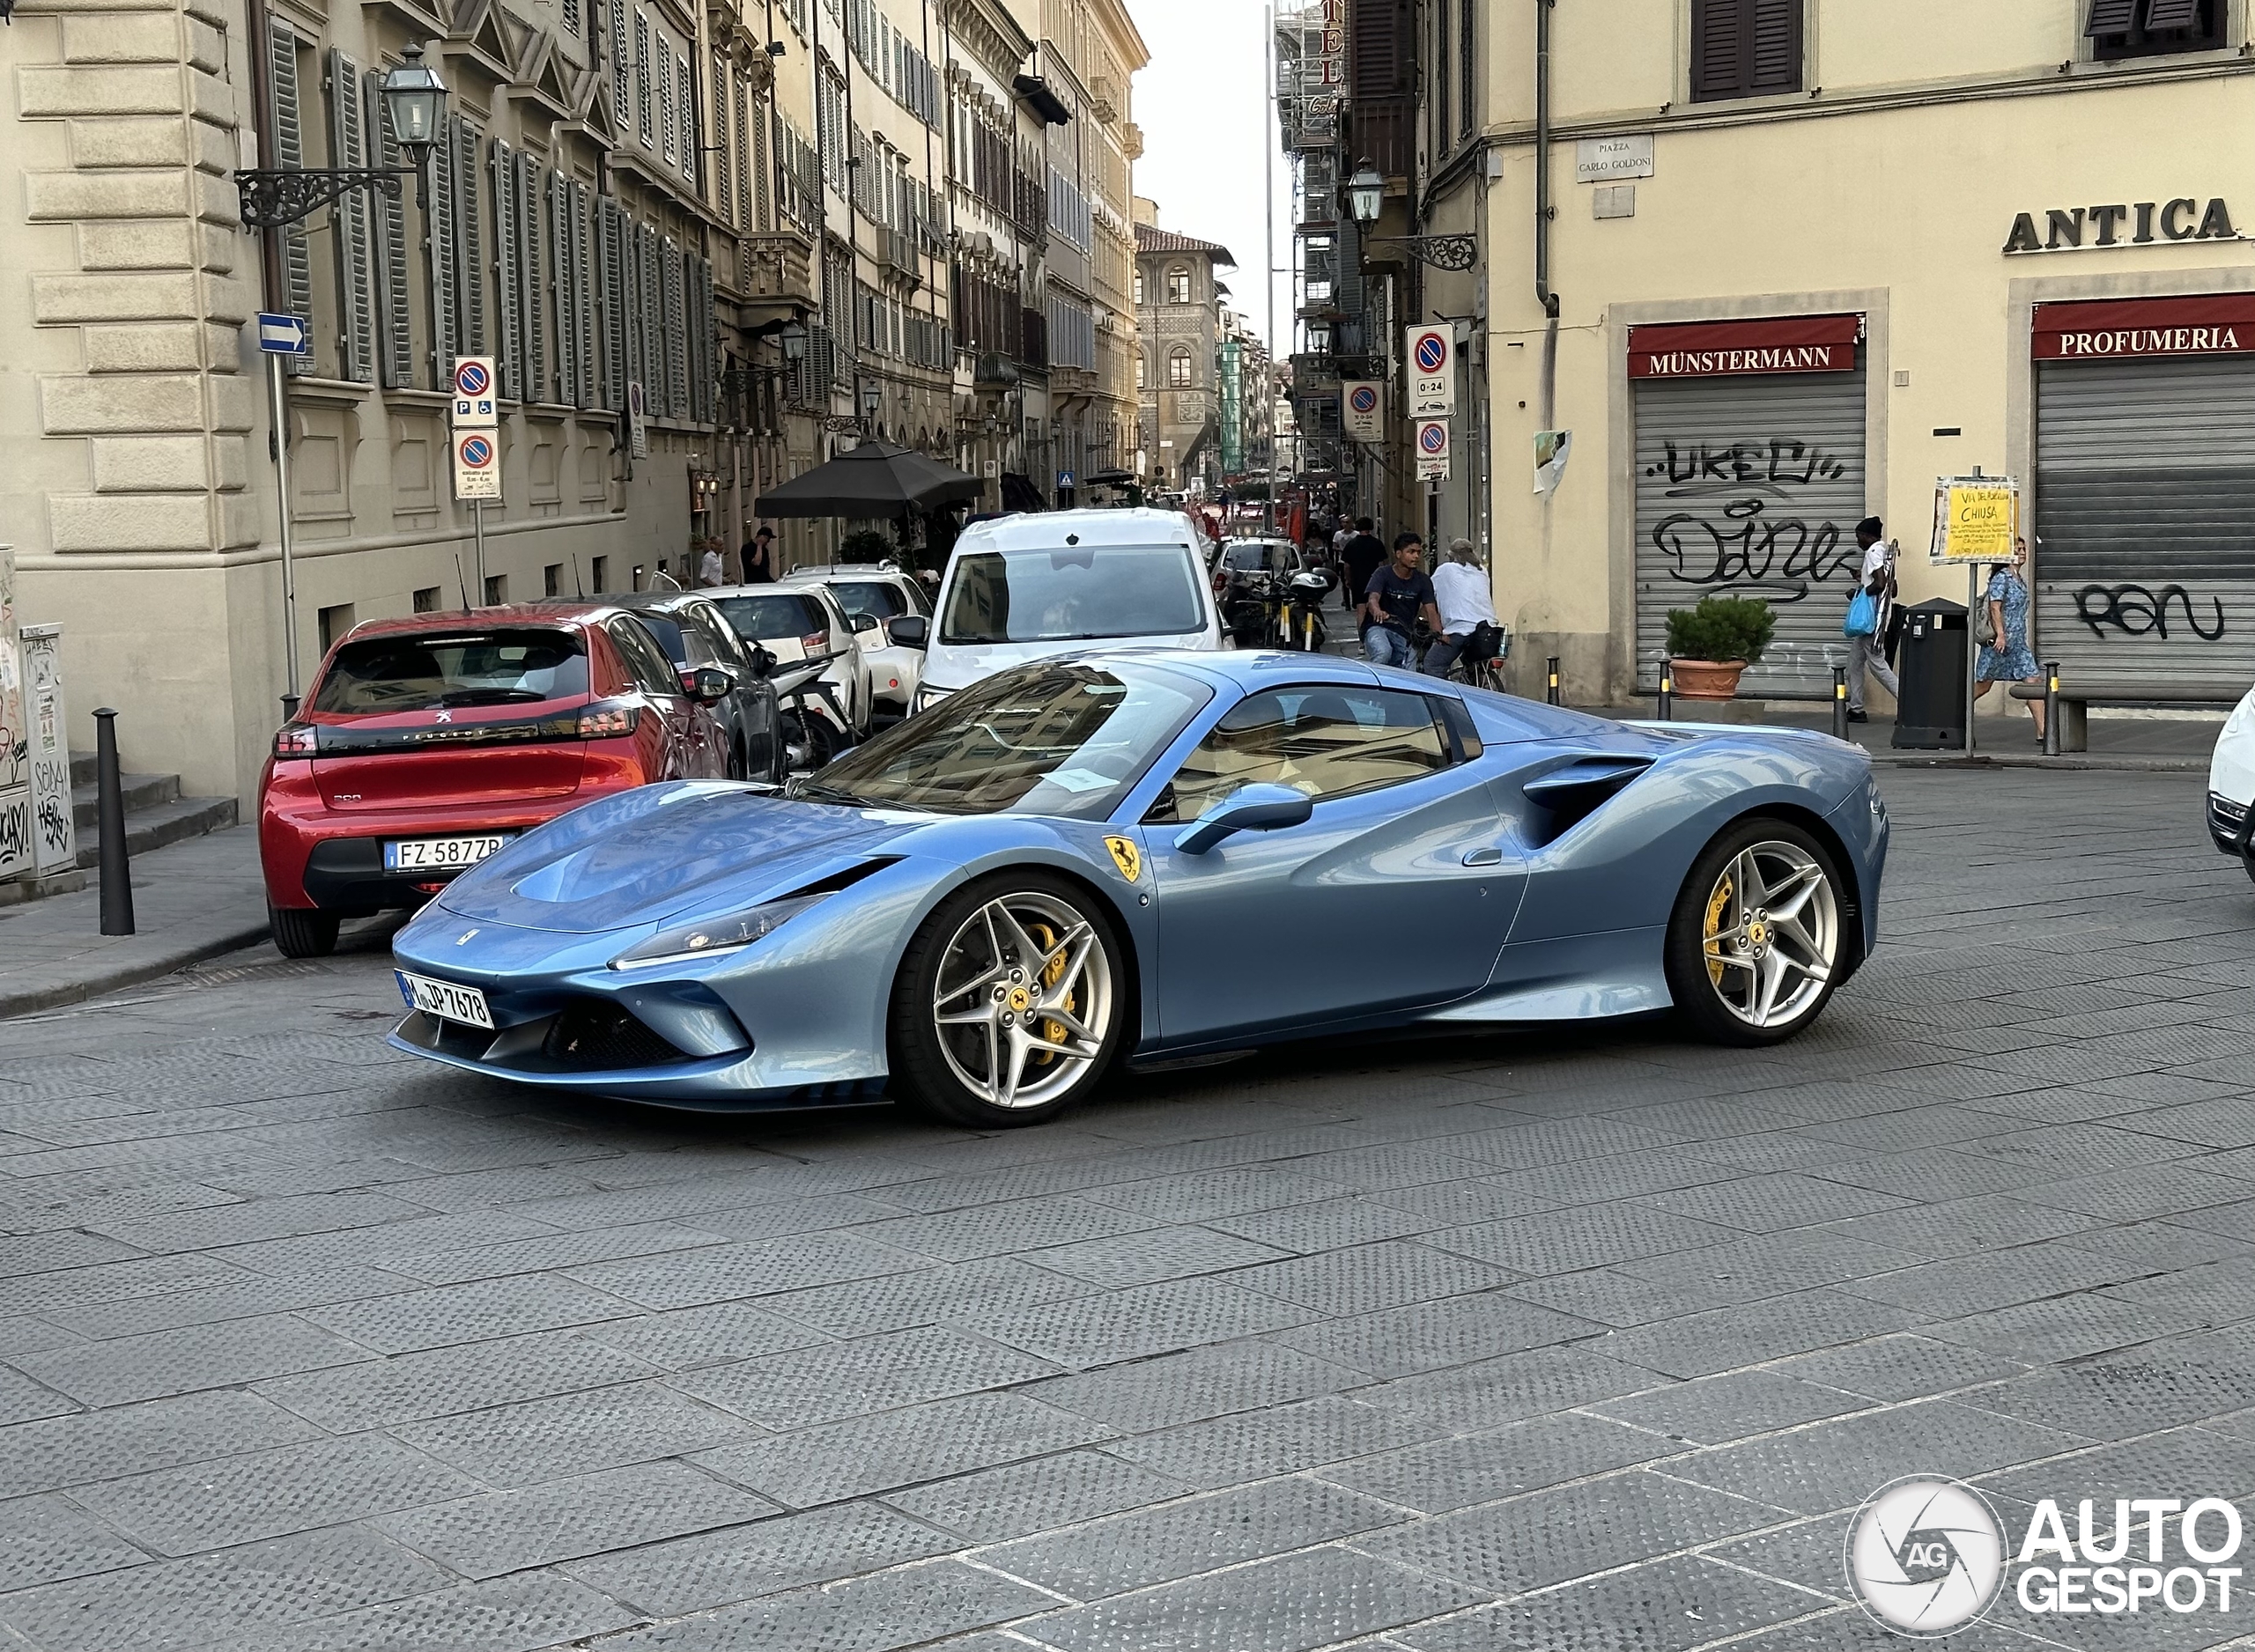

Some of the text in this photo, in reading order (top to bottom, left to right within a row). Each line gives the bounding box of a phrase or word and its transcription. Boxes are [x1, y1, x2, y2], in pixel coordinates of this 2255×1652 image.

[1599, 143, 1630, 152] PIAZZA
[1578, 158, 1651, 172] CARLO GOLDONI
[2002, 198, 2237, 252] ANTICA
[2059, 328, 2239, 355] PROFUMERIA
[1648, 346, 1832, 375] MÜNSTERMANN
[1961, 506, 1998, 522] CHIUSA
[403, 730, 484, 741] PEUGEOT
[401, 844, 425, 865] FZ
